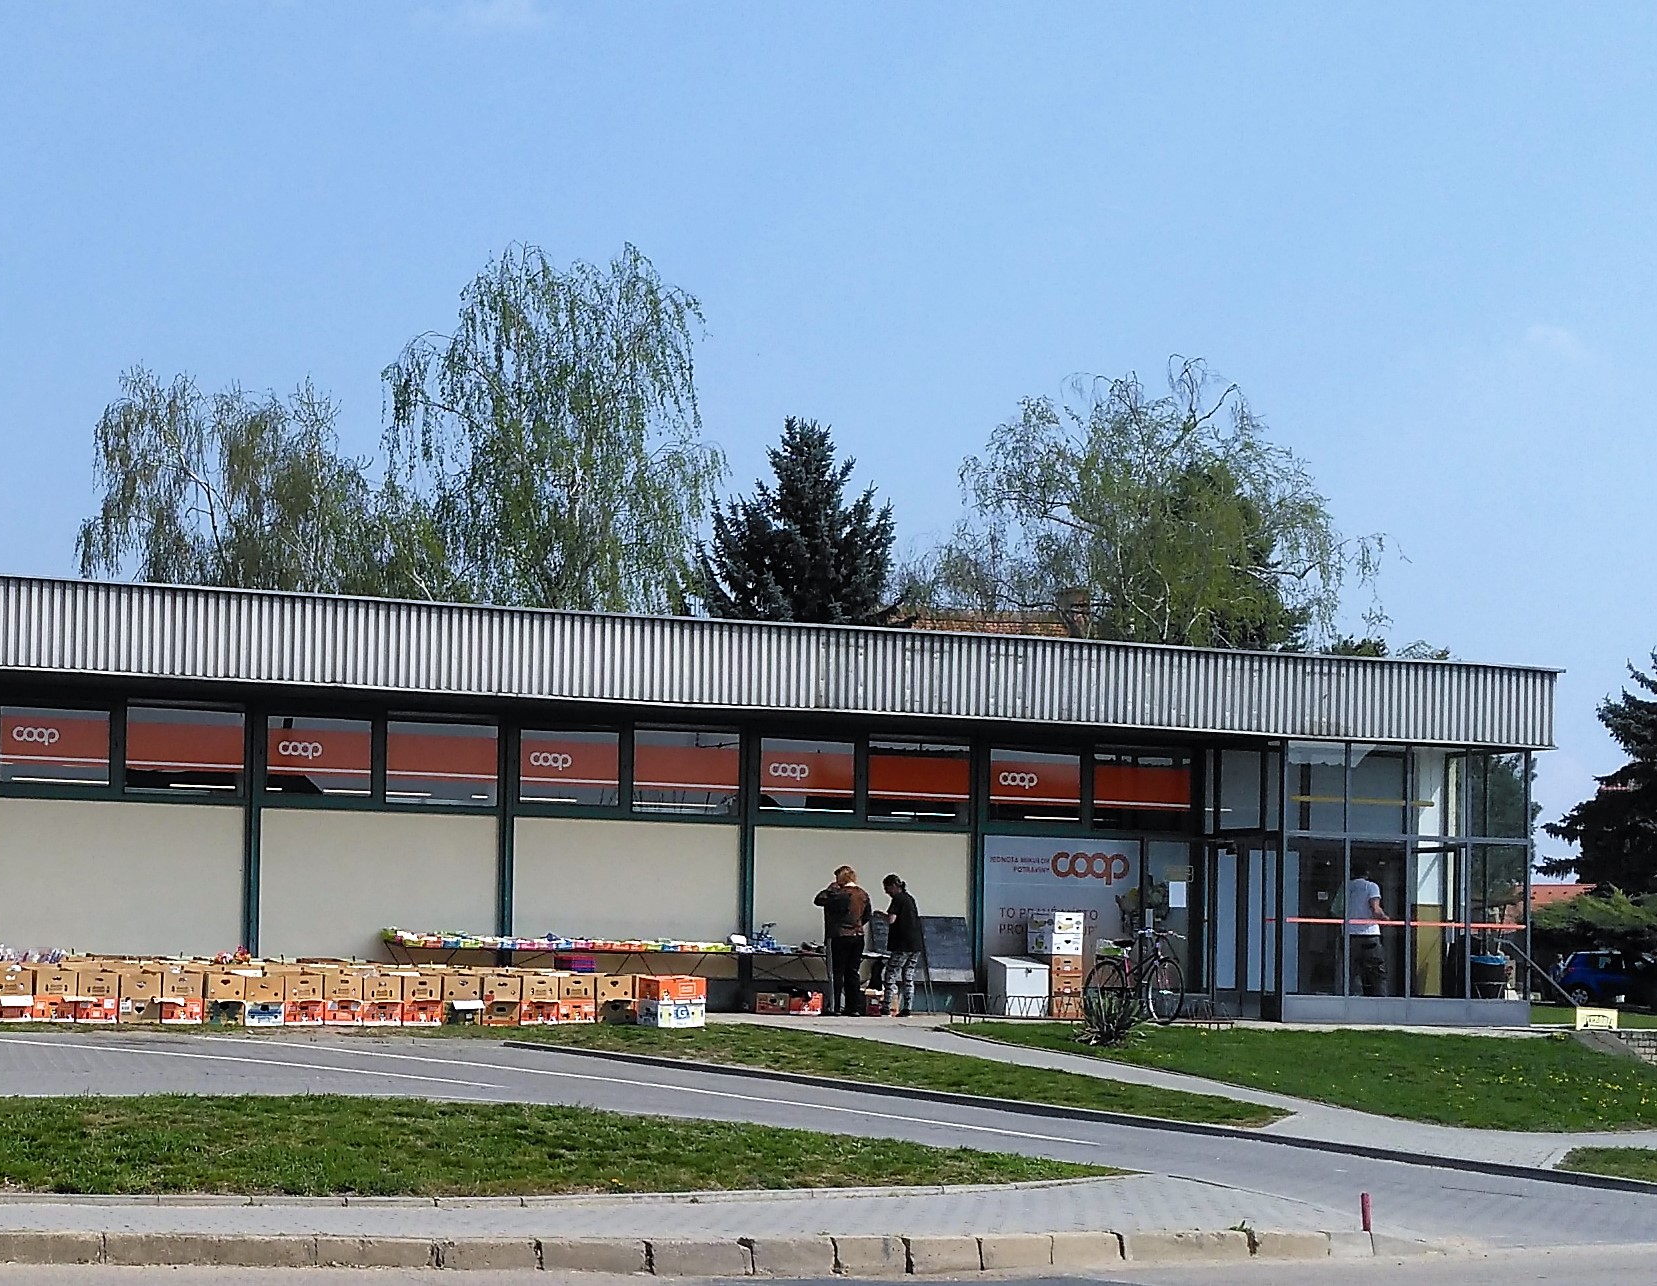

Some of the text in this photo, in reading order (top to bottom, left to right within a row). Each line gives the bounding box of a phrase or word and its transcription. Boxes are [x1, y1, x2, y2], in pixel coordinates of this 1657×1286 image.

[12, 726, 59, 746] coop
[278, 740, 323, 760] coop
[529, 752, 572, 771] coop
[769, 763, 809, 781] coop
[999, 771, 1038, 789] coop
[1051, 851, 1130, 887] coop
[999, 907, 1015, 919] TO
